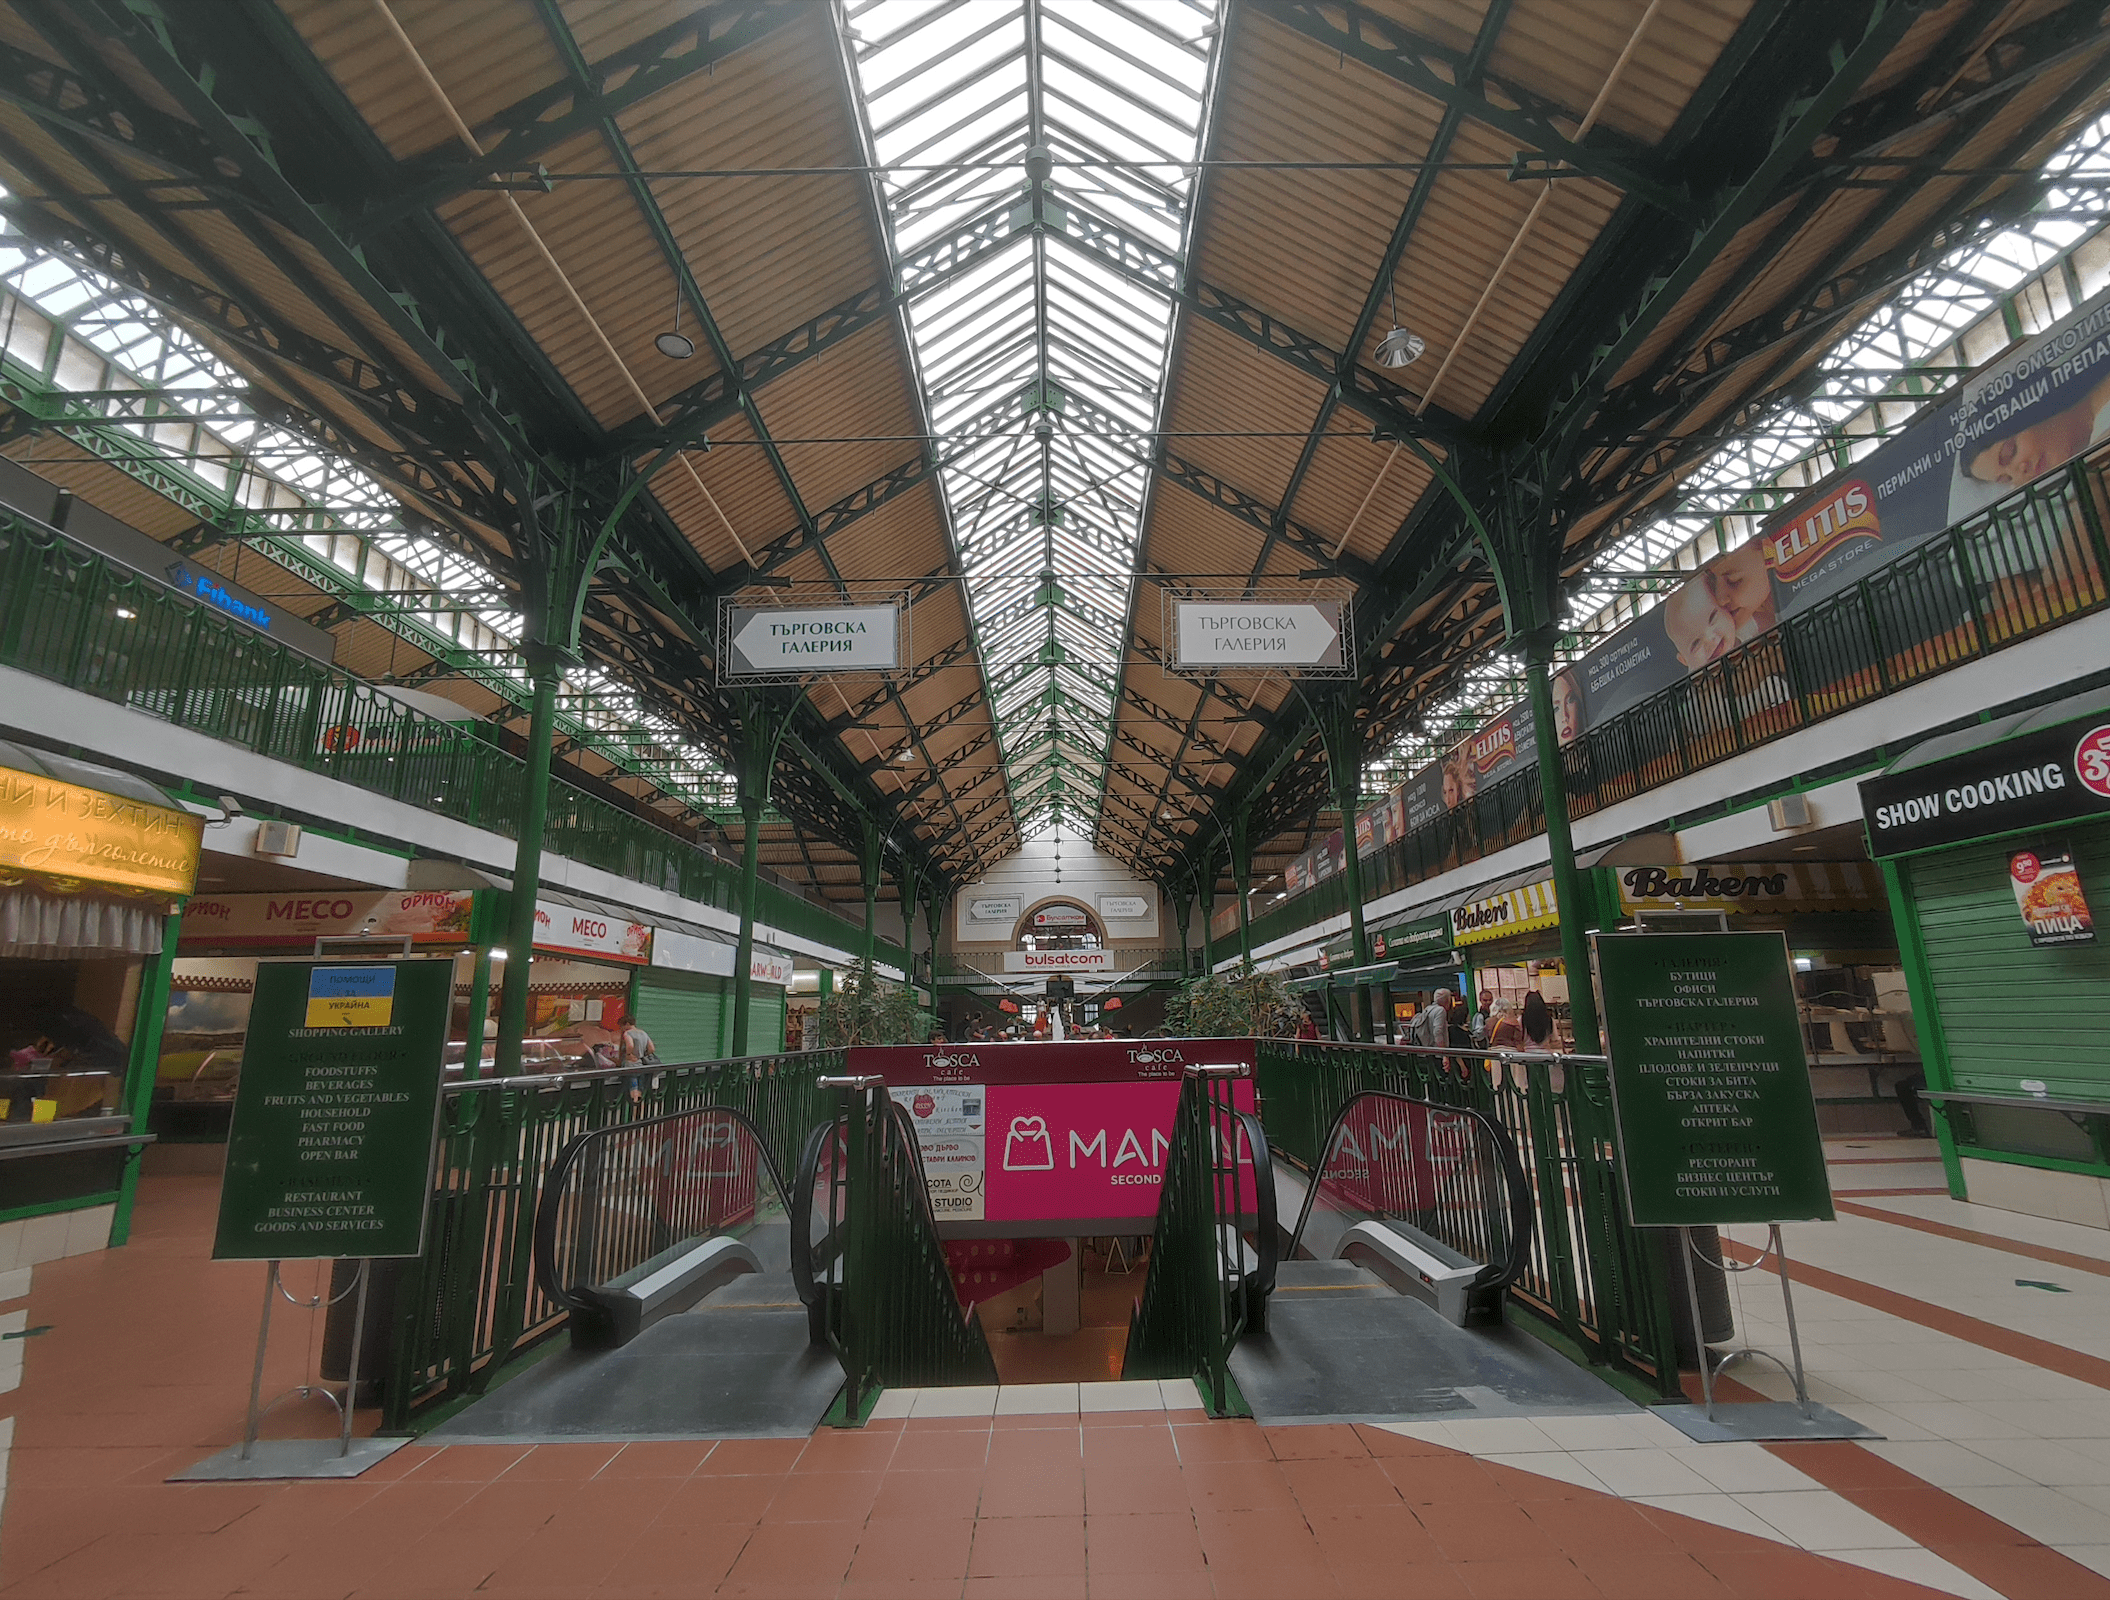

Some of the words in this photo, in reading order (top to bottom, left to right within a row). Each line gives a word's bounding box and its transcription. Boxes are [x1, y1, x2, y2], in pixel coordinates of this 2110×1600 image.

[1978, 371, 2014, 404] 1300
[1877, 453, 1932, 500] ПЕРИЛНИ
[1943, 378, 2049, 457] ПОЧИСТВАЩИ
[1774, 486, 1868, 566] ELITIS
[1792, 568, 1827, 592] MEGA
[1828, 539, 1873, 571] STORE
[197, 576, 271, 631] Fibank
[770, 622, 867, 636] ТЪРГОВСКА
[1198, 616, 1297, 630] ТЪРГОВСКА
[782, 640, 852, 654] ГАЛЕРИЯ
[1214, 638, 1286, 651] ГАЛЕРИЯ
[1615, 645, 1652, 677] КОЗМЕТИКА
[1475, 723, 1511, 760] ELITIS
[1875, 793, 1940, 830] SHOW
[1945, 763, 2066, 813] COOKING
[46, 787, 68, 816] И
[79, 794, 183, 839] ЗЕХТИН
[20, 832, 191, 873] дълголетие
[1623, 867, 1788, 897] Bakers
[266, 899, 354, 921] МЕСО
[1453, 901, 1508, 931] Bakers
[572, 916, 607, 939] МЕСО
[2034, 915, 2085, 935] ПИЦА
[1025, 953, 1104, 965] bulsatcom
[330, 974, 376, 985] ПОМОЩИ
[1669, 971, 1717, 981] БУТИЦИ
[1673, 984, 1717, 994] ОФИСИ
[328, 1000, 371, 1010] УКРАЙНА
[1636, 998, 1704, 1008] ТЪРГОВСКА
[1706, 997, 1759, 1007] ГАЛЕРИЯ
[288, 1027, 347, 1038] SHOPPING
[350, 1026, 405, 1036] GALLERY
[1644, 1036, 1722, 1046] ХРАНИТЕЛНИ
[1724, 1035, 1765, 1045] СТОКИ
[923, 1052, 981, 1068] TOSCA
[1126, 1048, 1185, 1064] TOSCA
[1677, 1049, 1736, 1060] НАПИТКИ
[304, 1065, 378, 1077] FOODSTUFFS
[940, 1067, 964, 1075] cafe
[1639, 1063, 1695, 1074] ПЛОДОВЕ
[1697, 1063, 1706, 1072] И
[1709, 1062, 1780, 1073] ЗЕЛЕНЧУЦИ
[305, 1079, 374, 1090] BEVERAGES
[1665, 1077, 1706, 1087] СТОКИ
[1710, 1076, 1723, 1086] ЗА
[1725, 1076, 1757, 1086] БИТА
[264, 1095, 306, 1105] FRUITS
[306, 1094, 333, 1104] AND
[336, 1092, 410, 1103] VEGETABLES
[1666, 1090, 1703, 1100] БЪРЗА
[1706, 1090, 1760, 1100] ЗАКУСКА
[300, 1107, 371, 1118] HOUSEHOLD
[1691, 1104, 1740, 1114] АПТЕКА
[302, 1122, 330, 1132] FAST
[333, 1121, 365, 1131] FOOD
[1681, 1118, 1729, 1128] ОТКРИТ
[1731, 1117, 1754, 1127] БАР
[298, 1134, 366, 1146] PHARMACY
[935, 1144, 959, 1152] ДЪРВО
[300, 1150, 331, 1160] OPEN
[334, 1150, 359, 1160] BAR
[1688, 1158, 1758, 1168] РЕСТОРАНТ
[1110, 1174, 1161, 1185] SECOND
[1676, 1172, 1723, 1183] БИЗНЕС
[1725, 1171, 1775, 1182] ЦЕНТЪР
[926, 1179, 951, 1188] СОТА
[284, 1191, 363, 1202] RESTAURANT
[1675, 1186, 1718, 1197] СТОКИ
[1719, 1187, 1729, 1196] И
[1731, 1185, 1781, 1197] УСЛУГИ
[934, 1197, 973, 1207] STUDIO
[267, 1206, 324, 1217] BUSINESS
[326, 1205, 375, 1216] CENTER
[254, 1221, 297, 1232] GOODS
[298, 1221, 323, 1231] AND
[325, 1219, 384, 1231] SERVICES
